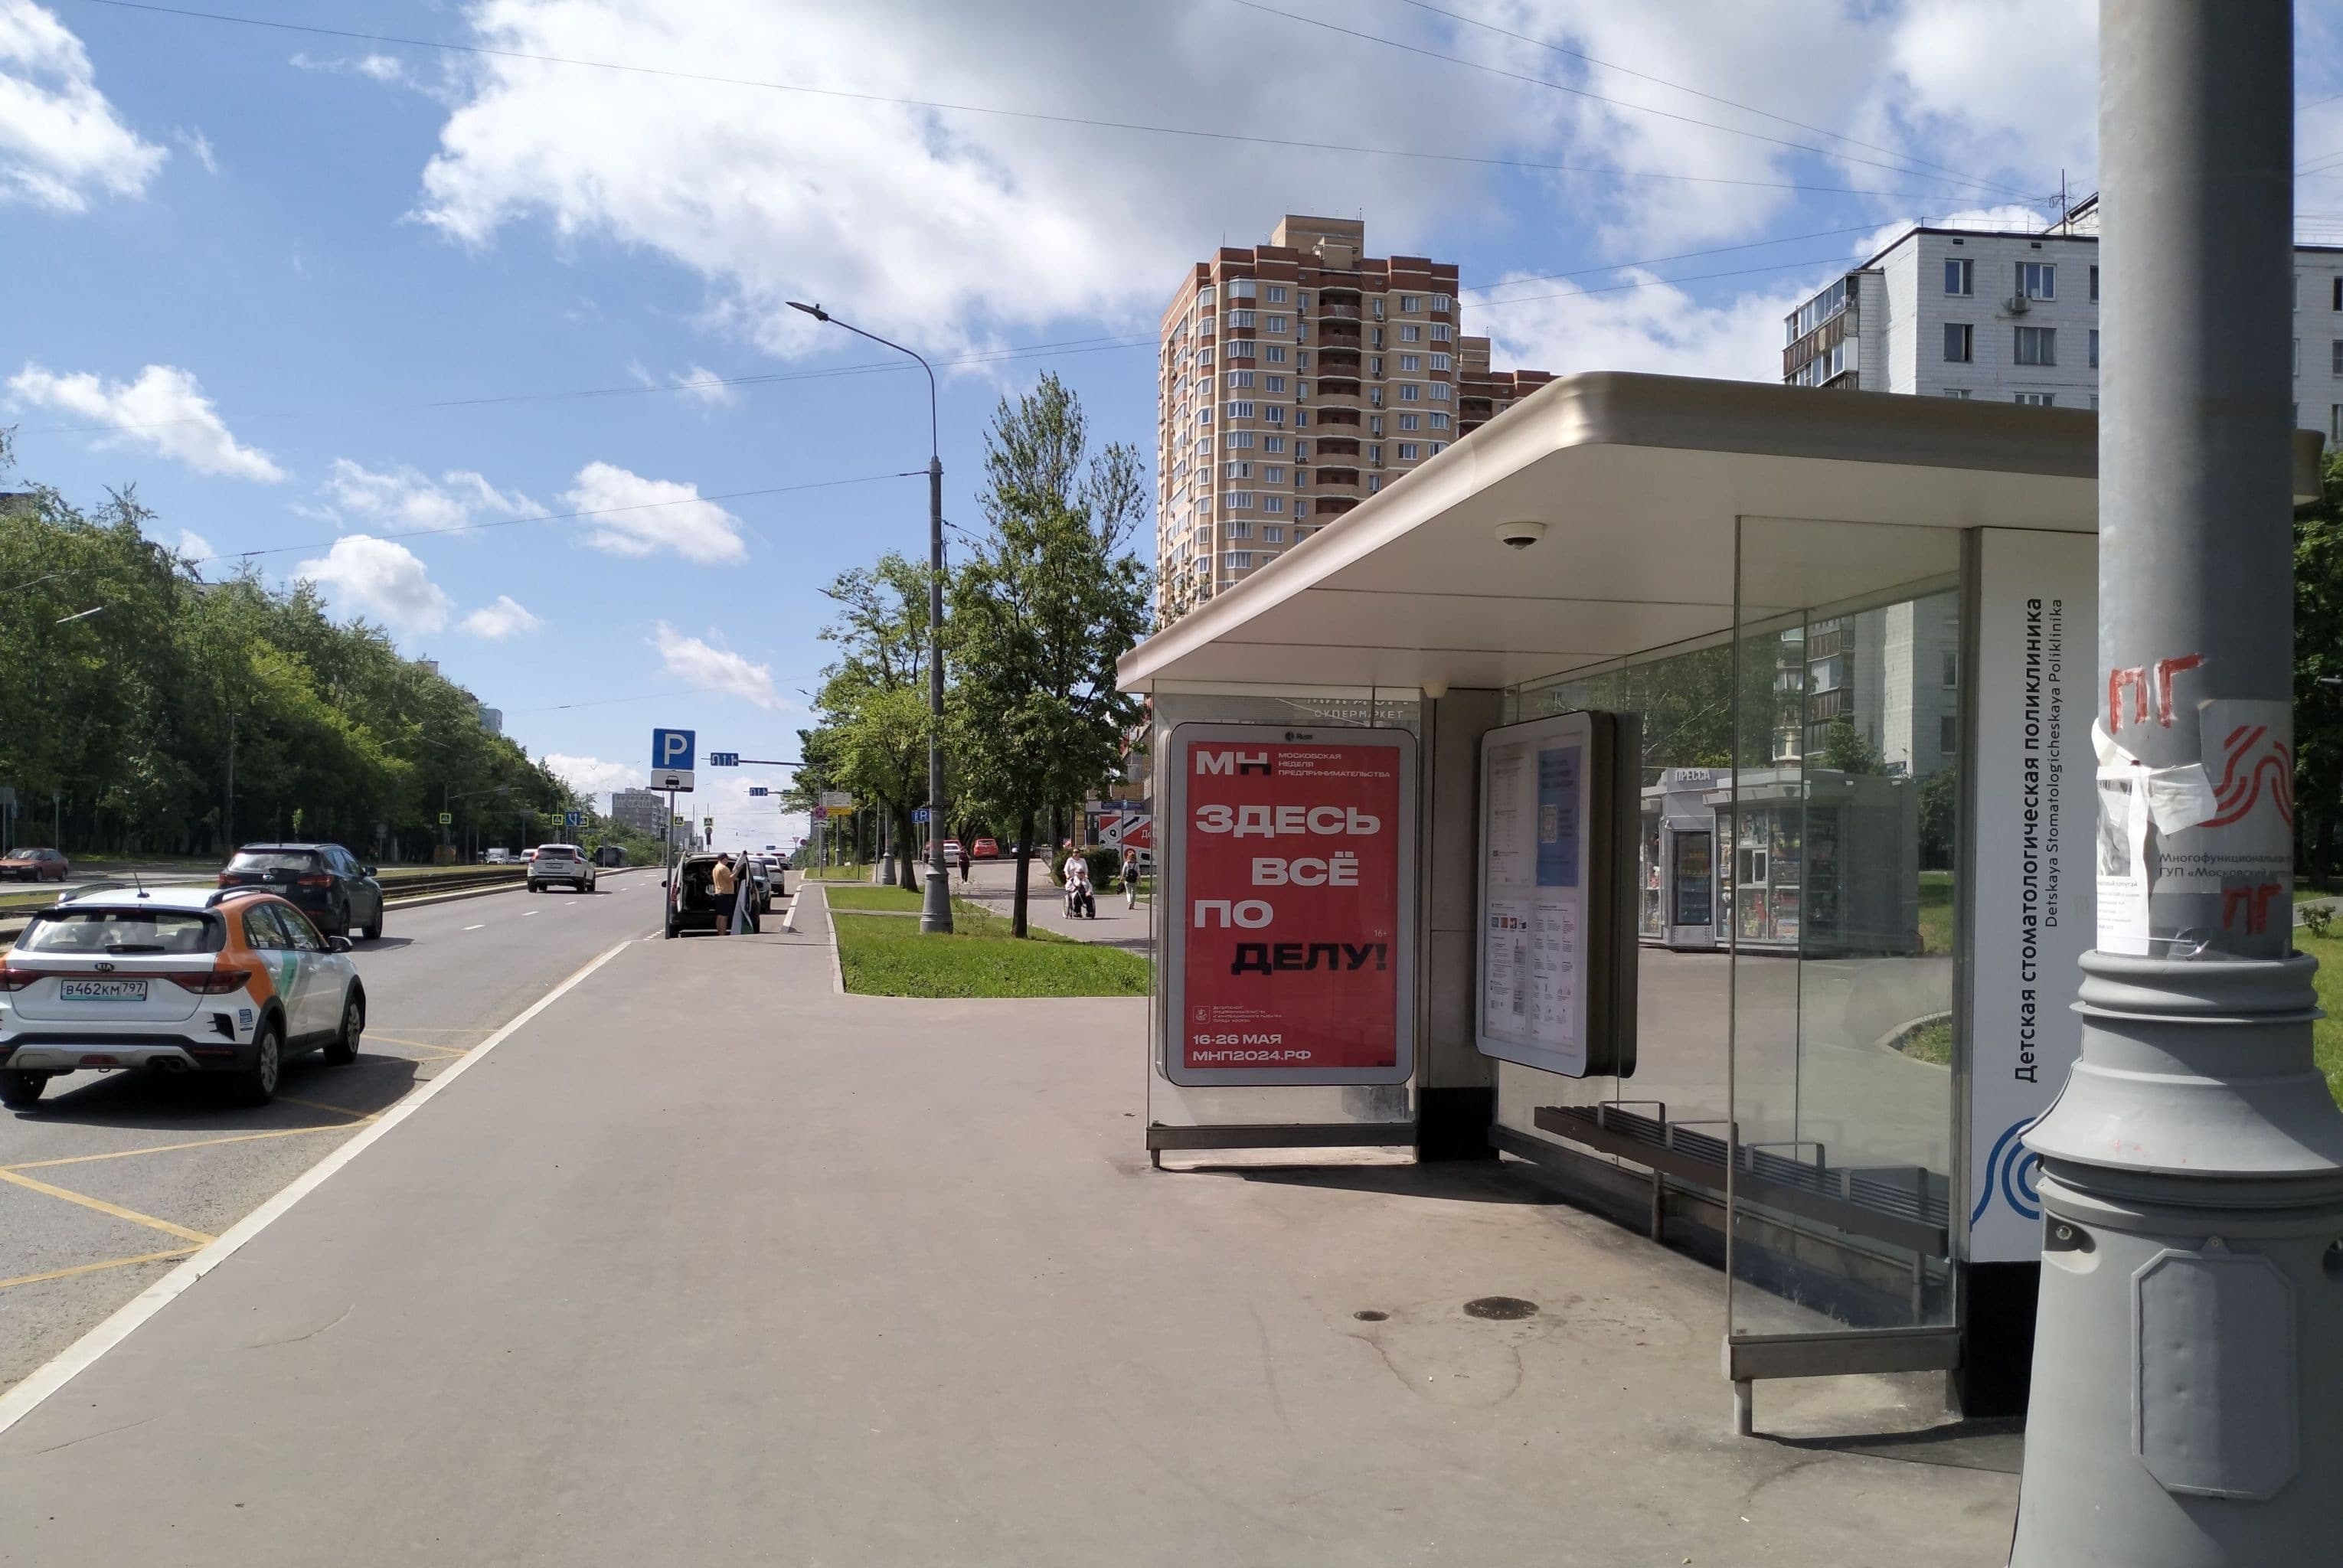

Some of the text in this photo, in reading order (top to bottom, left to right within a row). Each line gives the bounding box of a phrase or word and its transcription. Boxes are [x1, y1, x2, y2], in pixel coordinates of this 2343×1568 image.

[664, 733, 688, 765] P
[2046, 599, 2063, 927] Detskaya Stomatologicheskaya Poliklinika
[1278, 769, 1390, 778] ПРЕДПРИНИМАТЕЛЬСТВА
[1675, 769, 1711, 781] ПРЕССА
[1196, 805, 1381, 838] ЗДЕСЬ
[2015, 598, 2041, 1083] Детская стоматологическая поликлиника
[1252, 851, 1358, 886] ВСЁ
[2159, 867, 2184, 877] ГУП
[1194, 900, 1273, 929] ПО
[1231, 943, 1387, 975] ДЕЛУ!
[122, 982, 143, 993] 797
[1193, 1034, 1282, 1044] 16-26 МАЯ
[1193, 1050, 1311, 1061] МНП2024.РФ
